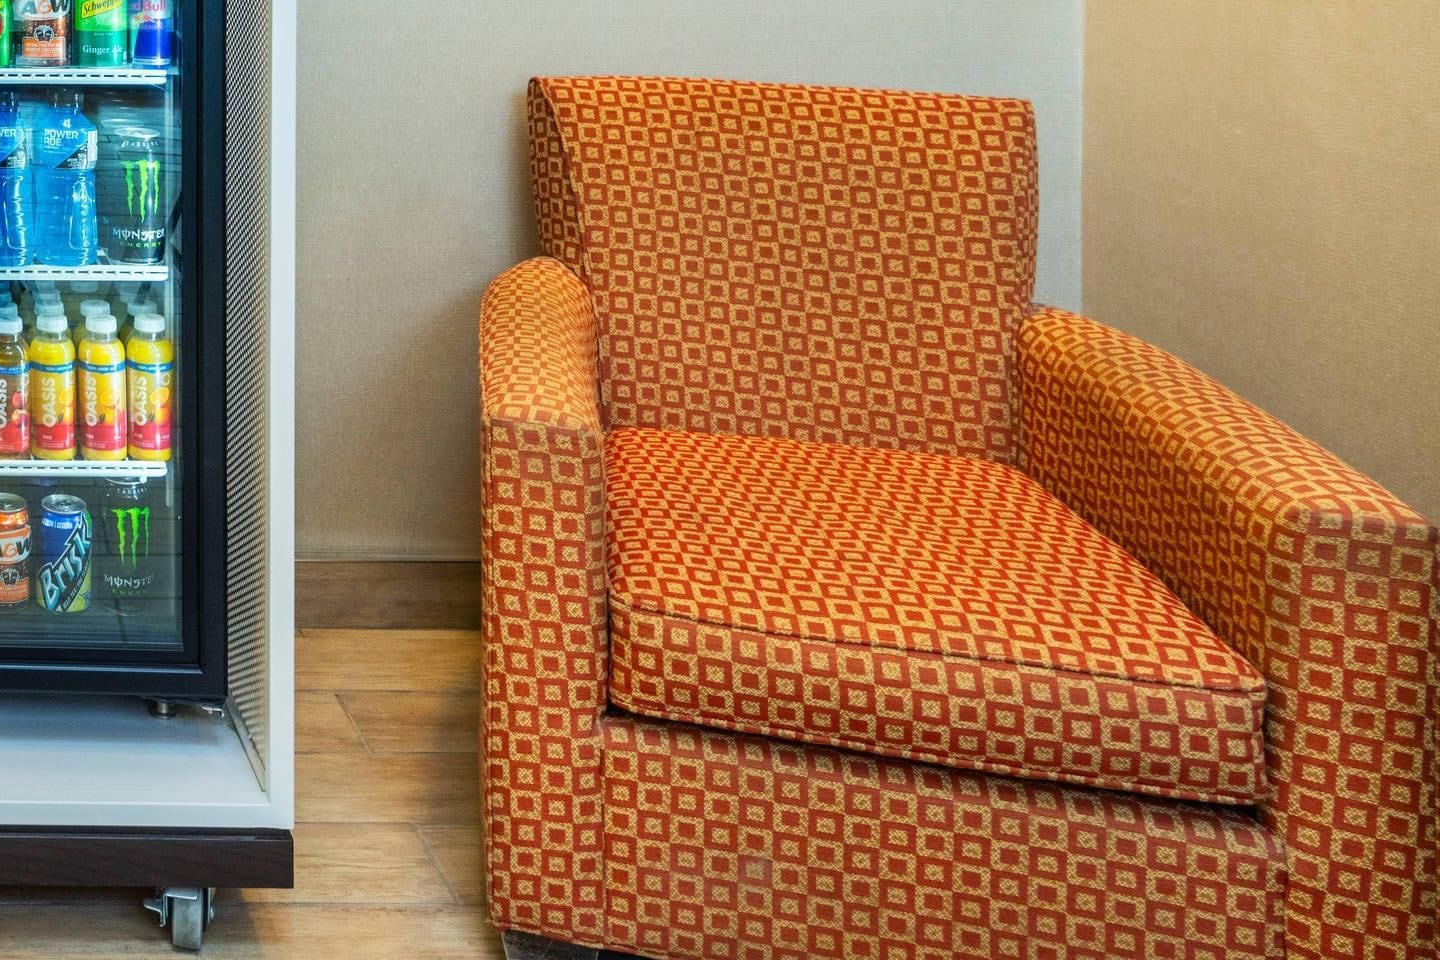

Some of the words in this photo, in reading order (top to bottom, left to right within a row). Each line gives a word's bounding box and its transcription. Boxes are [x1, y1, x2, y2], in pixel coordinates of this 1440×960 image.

[143, 0, 166, 11] Bull
[82, 45, 110, 56] Ginger
[44, 128, 79, 139] POWER
[42, 377, 56, 428] OASIS
[85, 376, 97, 427] OASIS
[135, 376, 147, 427] OASIS
